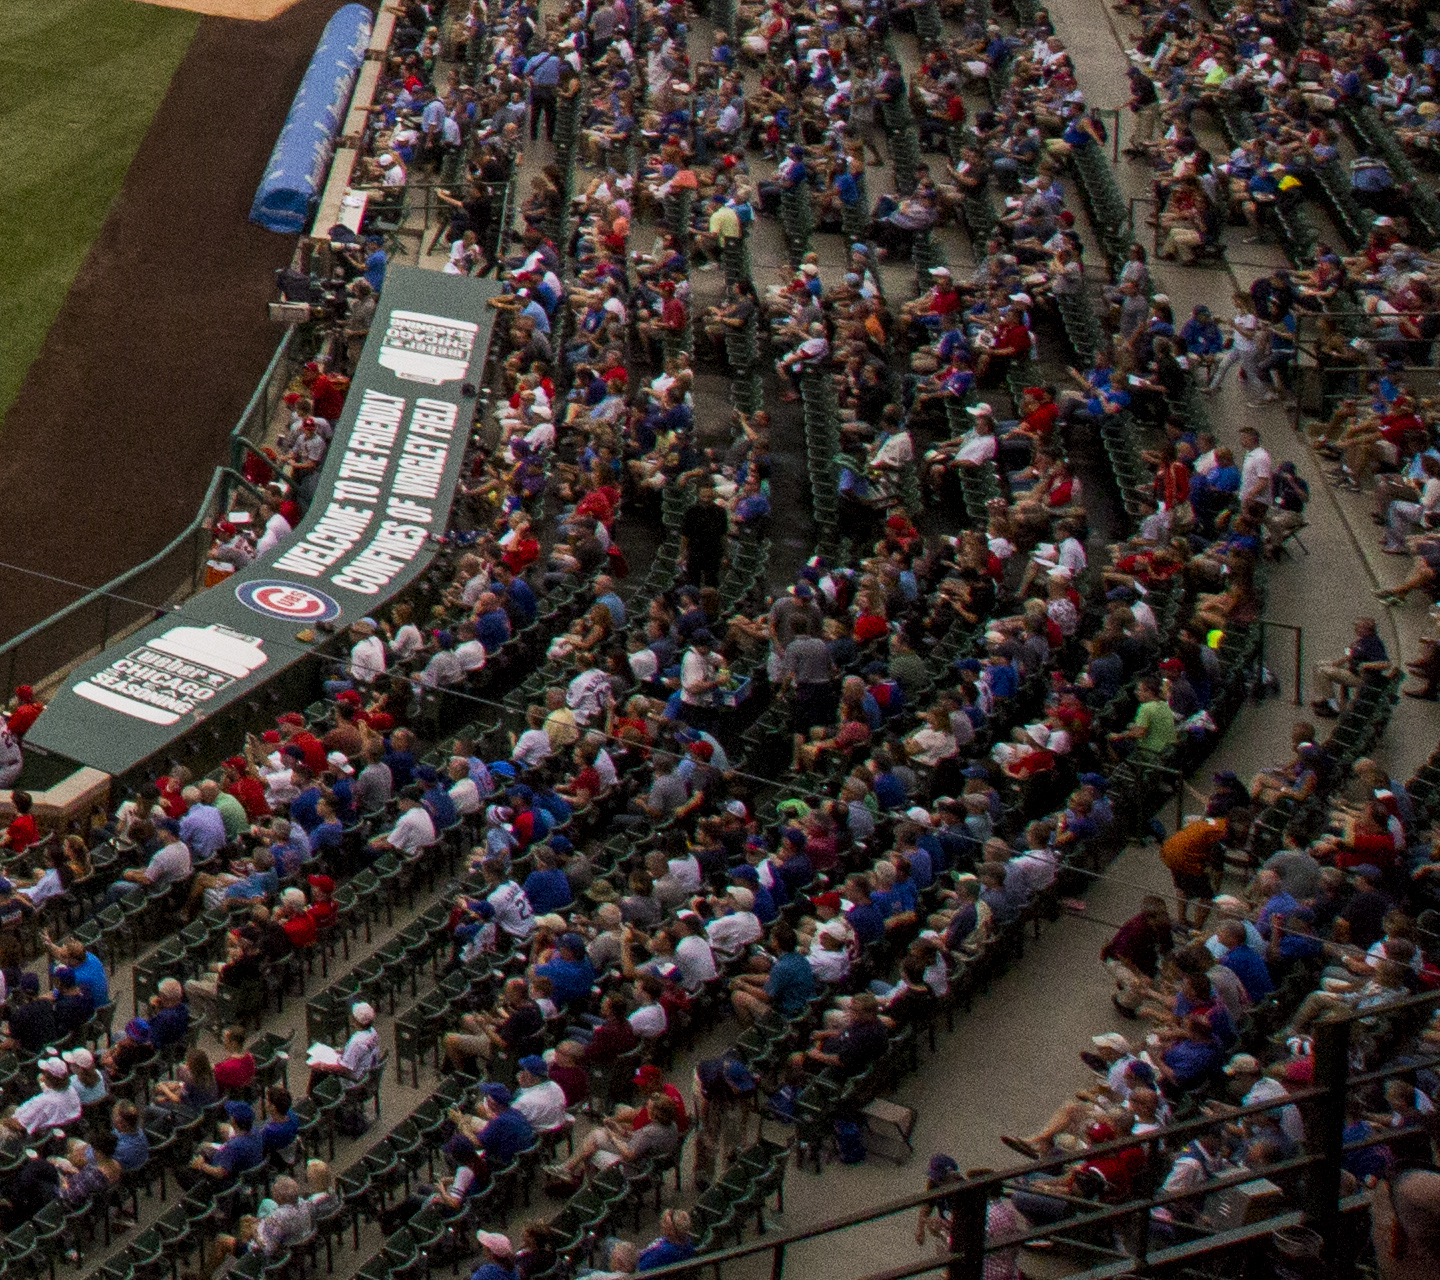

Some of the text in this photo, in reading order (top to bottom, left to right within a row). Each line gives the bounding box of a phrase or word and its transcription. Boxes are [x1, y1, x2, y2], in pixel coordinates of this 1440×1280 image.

[410, 397, 458, 439] FIELD
[272, 389, 406, 577] WELCOME TO THE FRIENDLY
[392, 434, 450, 499] WRIGLEY
[386, 497, 433, 523] OF
[330, 521, 429, 595] CONFINES
[112, 659, 216, 701] CHICAGO
[136, 651, 208, 679] weber
